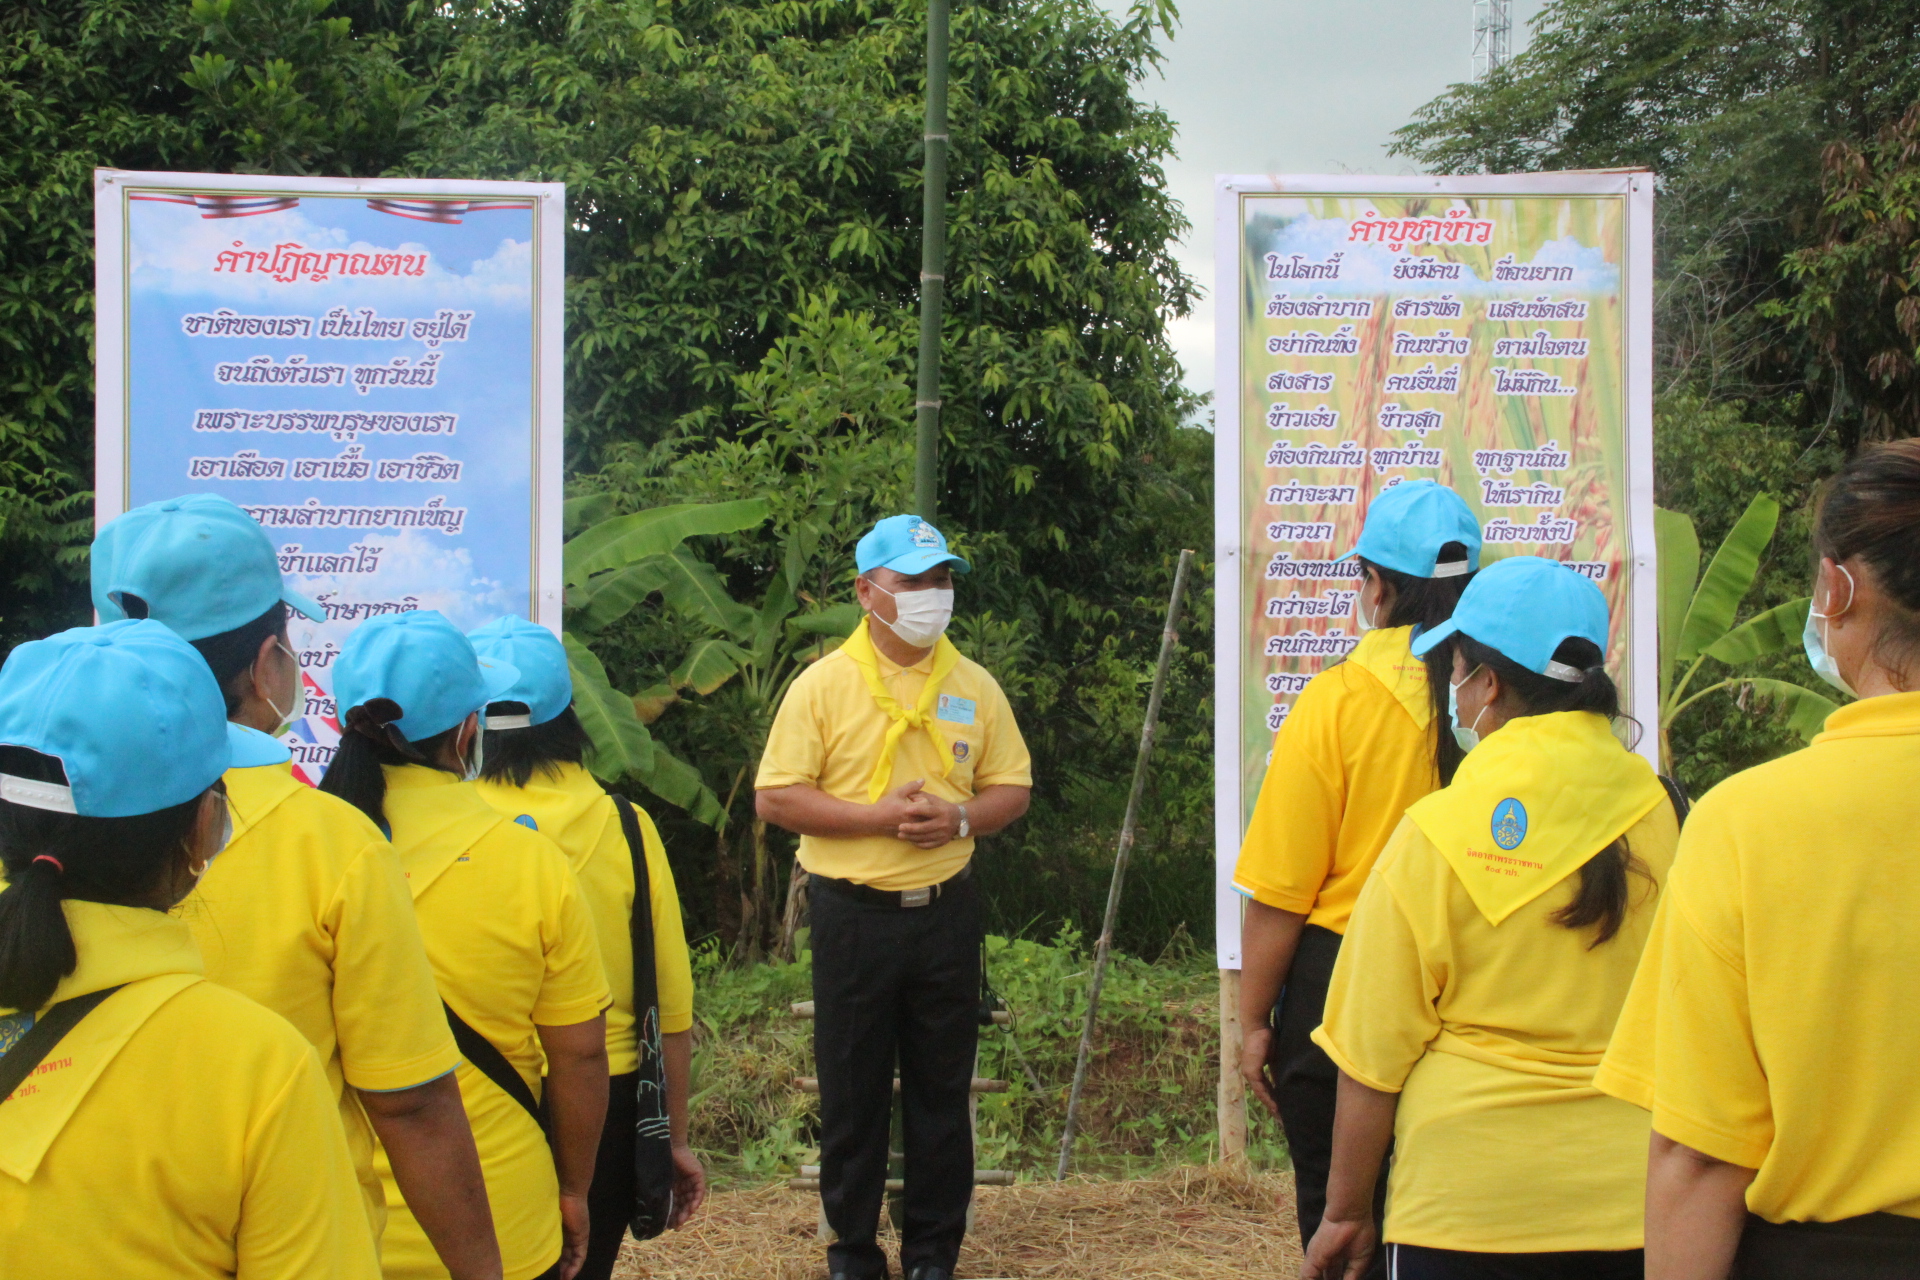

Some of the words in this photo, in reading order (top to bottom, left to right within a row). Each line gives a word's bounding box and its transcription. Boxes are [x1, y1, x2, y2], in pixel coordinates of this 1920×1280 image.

[1348, 210, 1493, 252] คำบูชาข้าว
[213, 240, 428, 283] คำปฏิญาณตน
[1267, 252, 1344, 279] ในโลกนี้
[1393, 257, 1460, 279] ยังมีคน
[1267, 294, 1371, 316] ต้องลำบาก
[1395, 295, 1461, 317] สารพัด
[1489, 296, 1586, 318] แสนขัดสน
[184, 311, 310, 338] ชาติของเรา
[320, 308, 404, 339] เป็นไทย
[412, 312, 471, 347] อยู่ได้
[1268, 326, 1358, 353] อย่ากินทิ้ง
[1395, 331, 1469, 354] กินขว้าง
[1495, 331, 1587, 356] ตามใจตน
[217, 357, 345, 385] จนถึงตัวเรา
[355, 354, 440, 393] ทุกวันนี้
[1268, 373, 1333, 390] สงสาร
[1386, 364, 1458, 391] คนอื่นที่
[195, 410, 455, 440] เพราะบรรพบุรุษของเรา
[1268, 405, 1337, 428] ข้าวเอ๋ย
[1380, 405, 1441, 434] ข้าวสุก
[190, 452, 283, 479] เอาเลือด
[293, 446, 369, 479] เอาเนื้อ
[378, 455, 461, 481] เอาชีวิต
[1267, 442, 1363, 465] ต้องกินกัน
[1373, 443, 1440, 472] ทุกบ้าน
[1475, 442, 1567, 474] ทุกฐานถิ่น
[1269, 482, 1355, 502] กว่าจะมา
[1482, 480, 1561, 505] ให้เรากิน
[243, 497, 464, 533] วามลำบากยากเข็ญ
[1270, 524, 1332, 540] ชาวนา
[1485, 514, 1574, 542] เกือบทั้งปี
[277, 545, 383, 573] ข้าแลกไว้
[1269, 592, 1355, 616] กว่าจะได้
